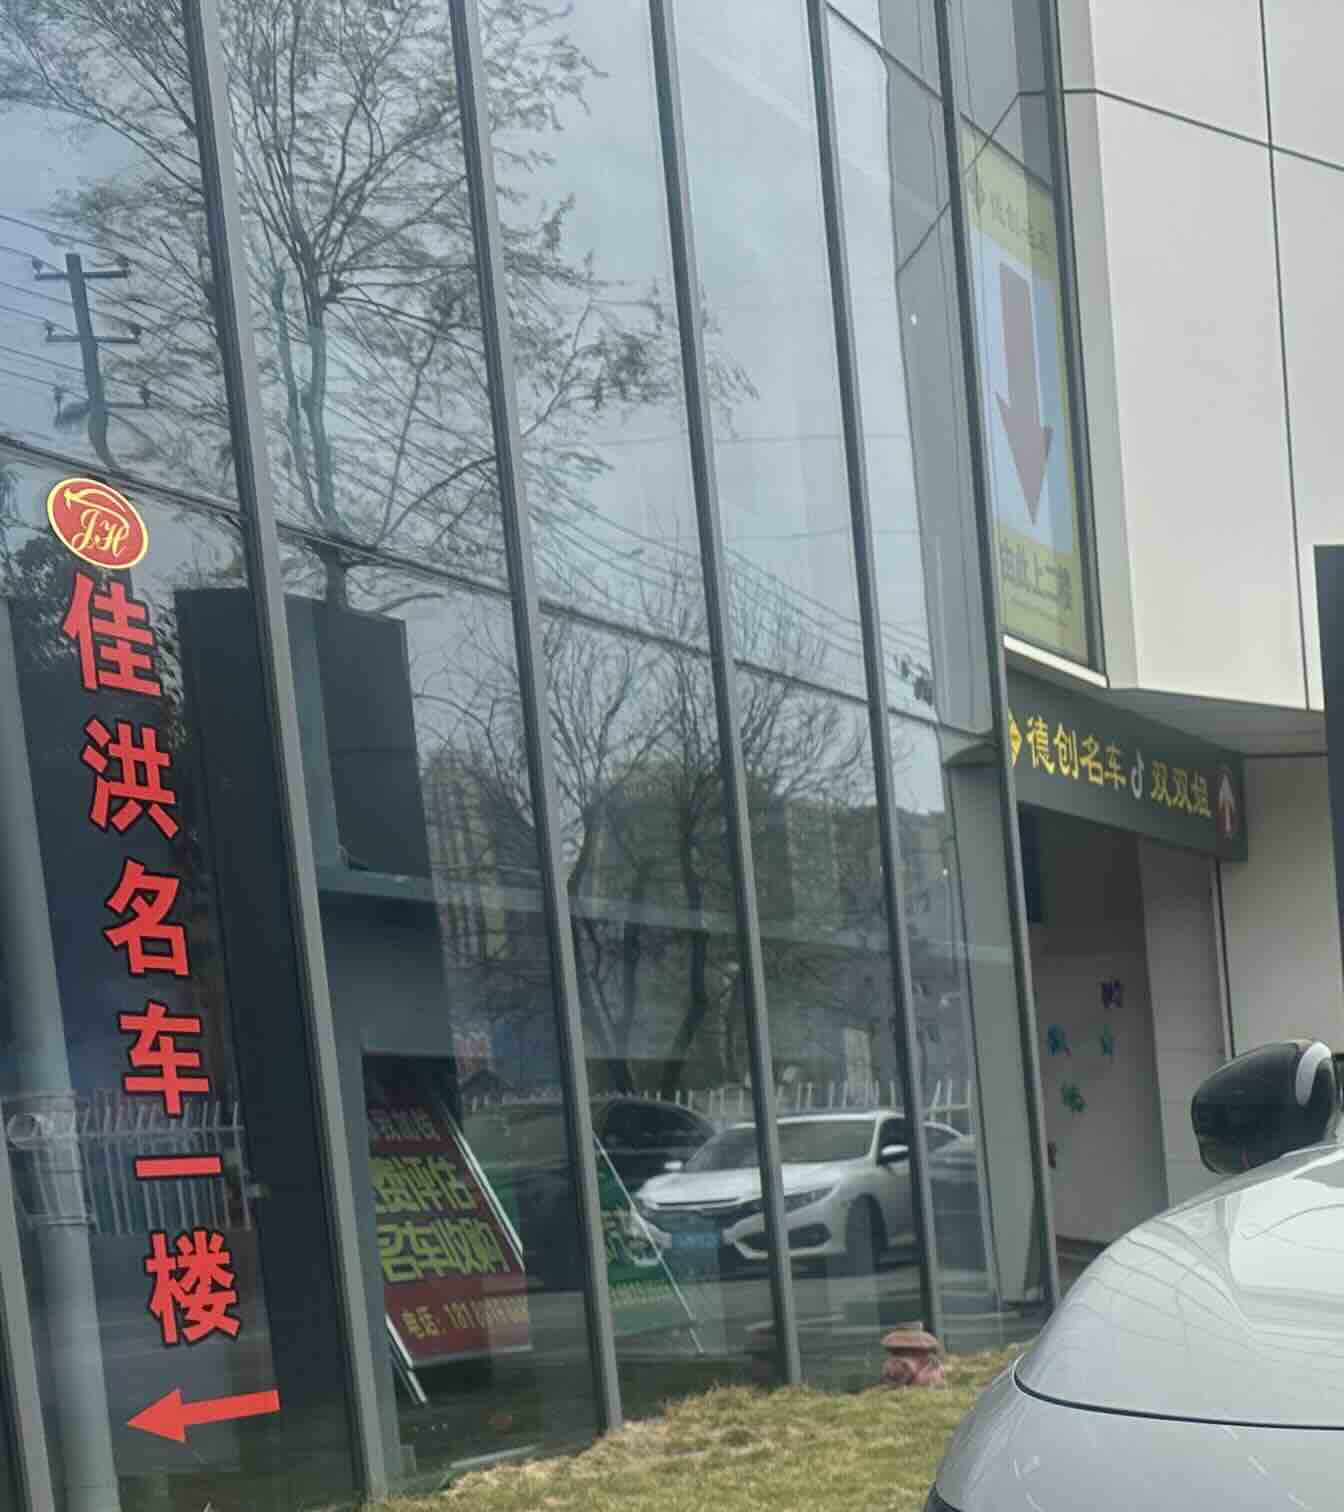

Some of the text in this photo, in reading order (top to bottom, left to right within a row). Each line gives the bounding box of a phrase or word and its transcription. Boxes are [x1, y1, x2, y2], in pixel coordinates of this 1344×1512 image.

[64, 573, 241, 1344] 佳洪名车一楼
[1026, 714, 1126, 791] 德创名车
